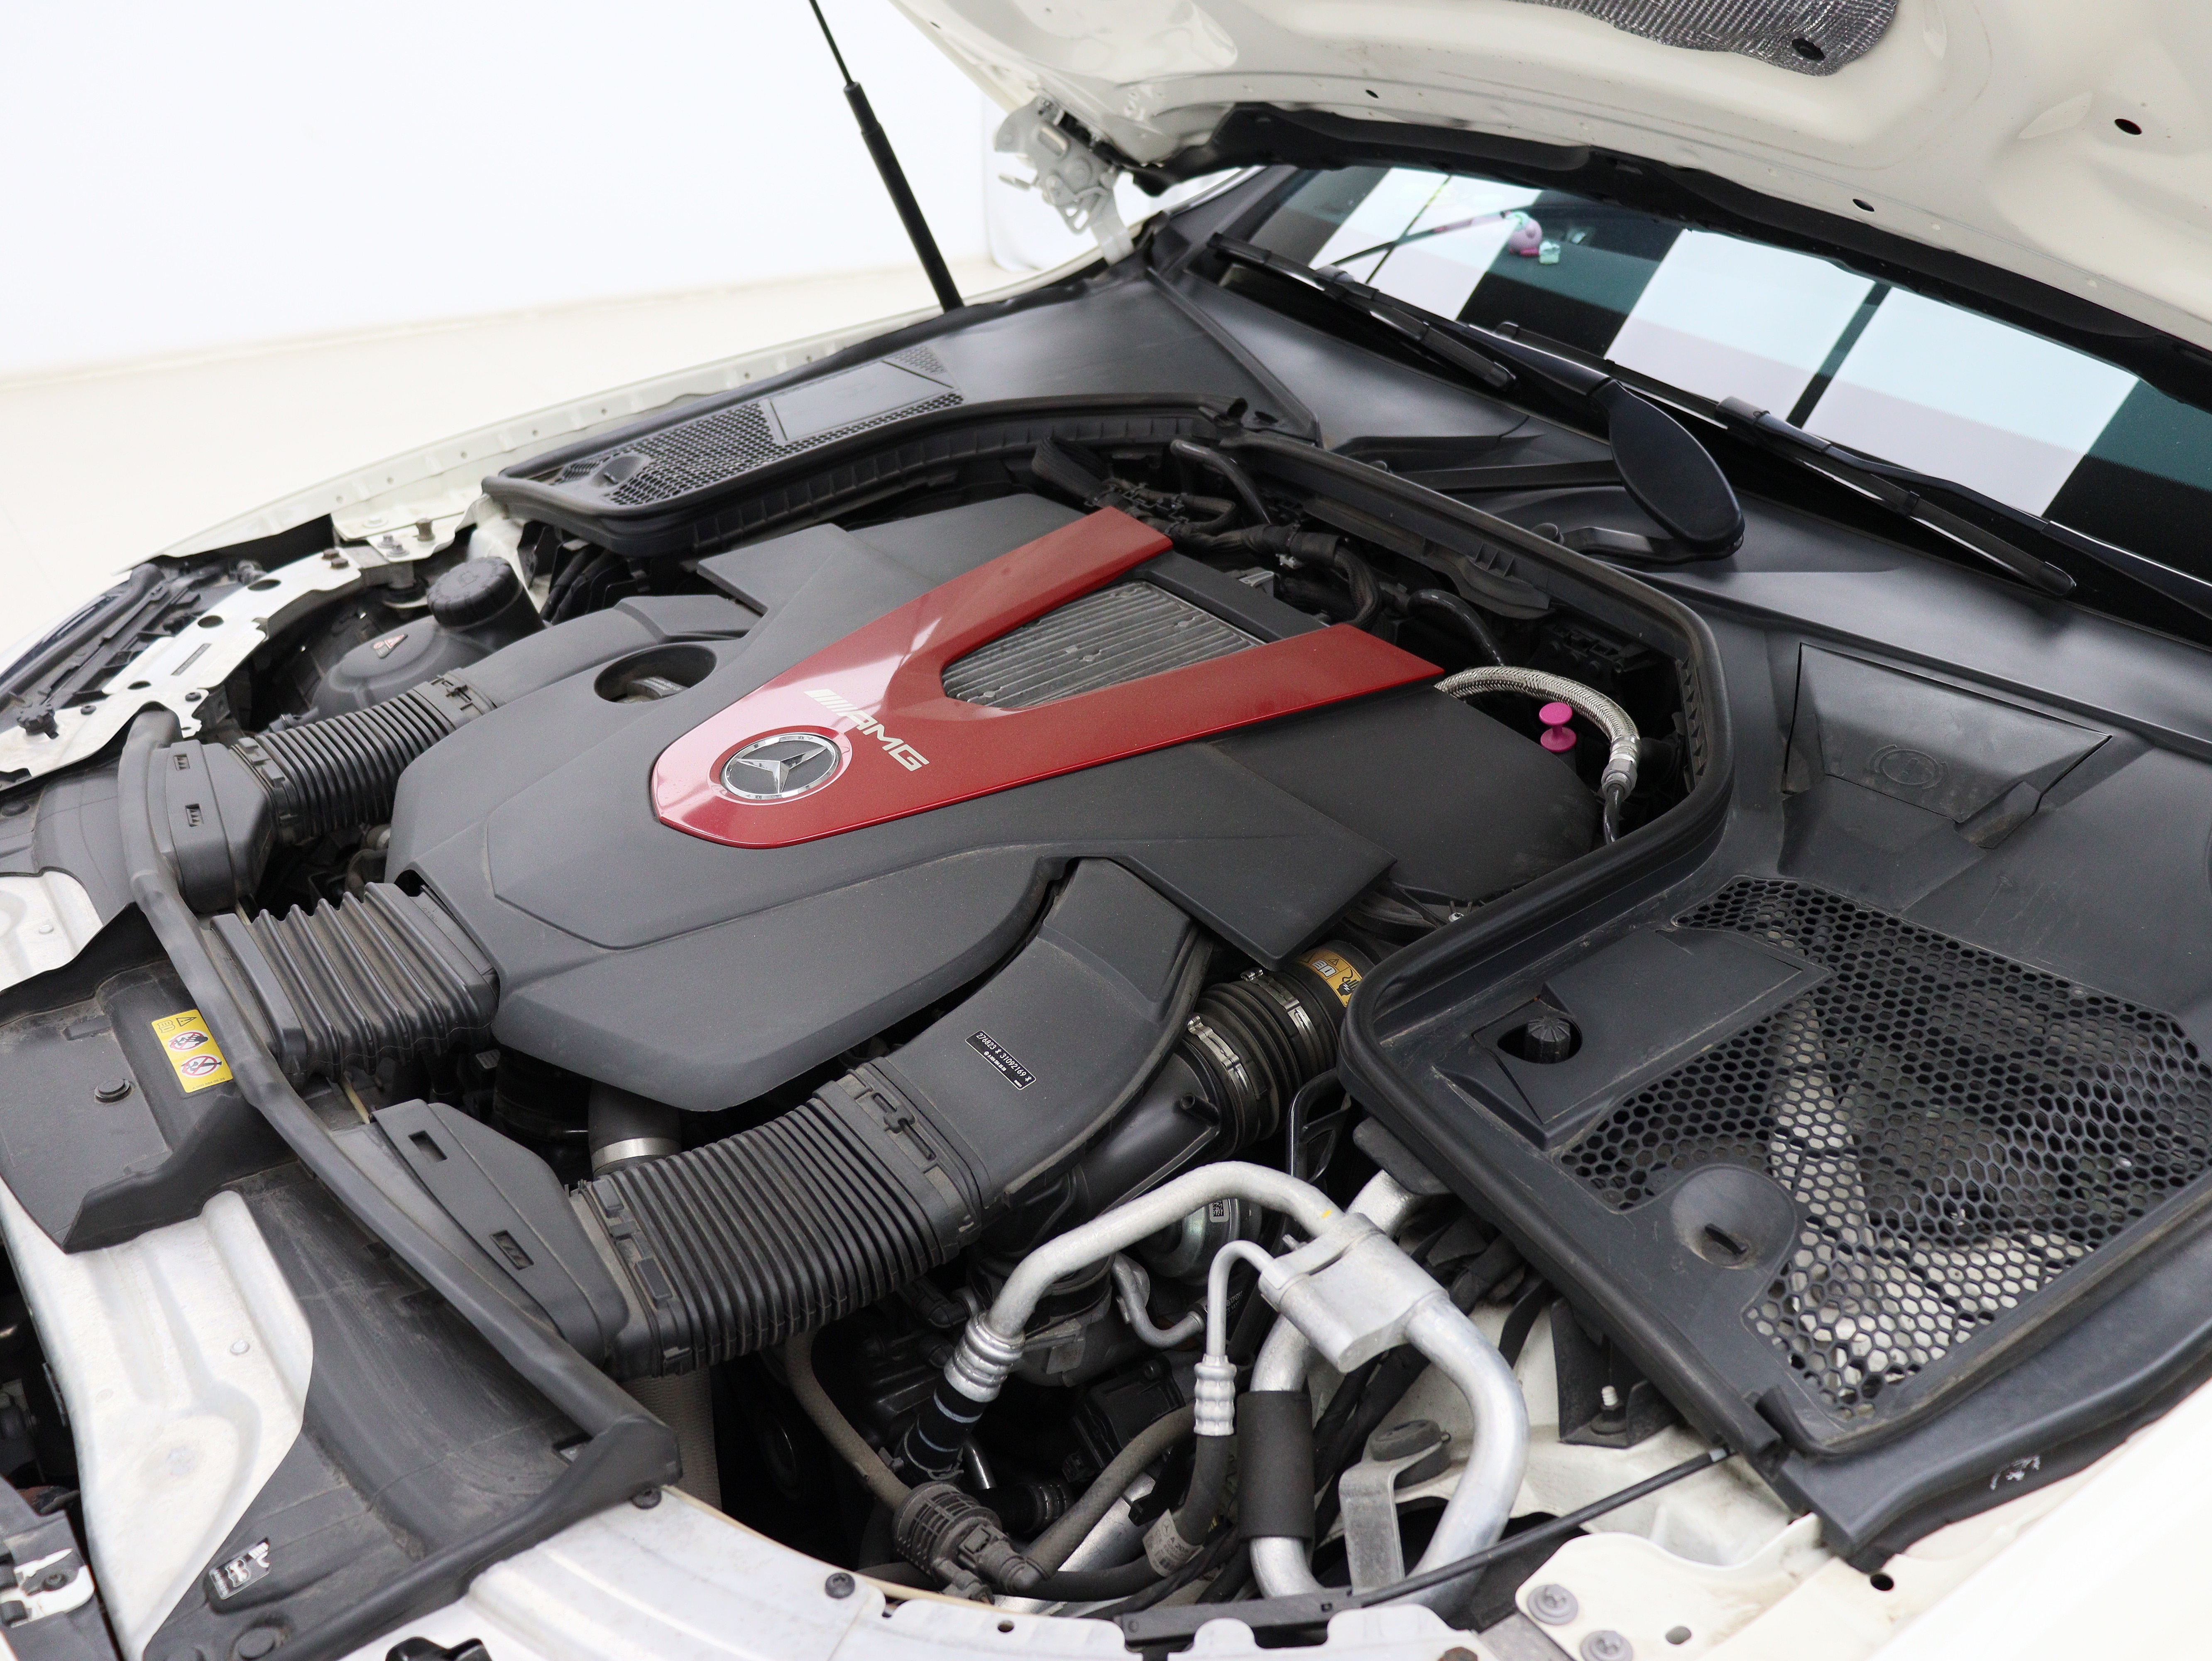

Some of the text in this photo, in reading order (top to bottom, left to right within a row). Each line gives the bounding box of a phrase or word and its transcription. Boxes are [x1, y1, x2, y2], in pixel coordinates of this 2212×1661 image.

[836, 710, 930, 772] AMG
[976, 1033, 997, 1050] 276823
[1000, 1053, 1027, 1076] 31092169
